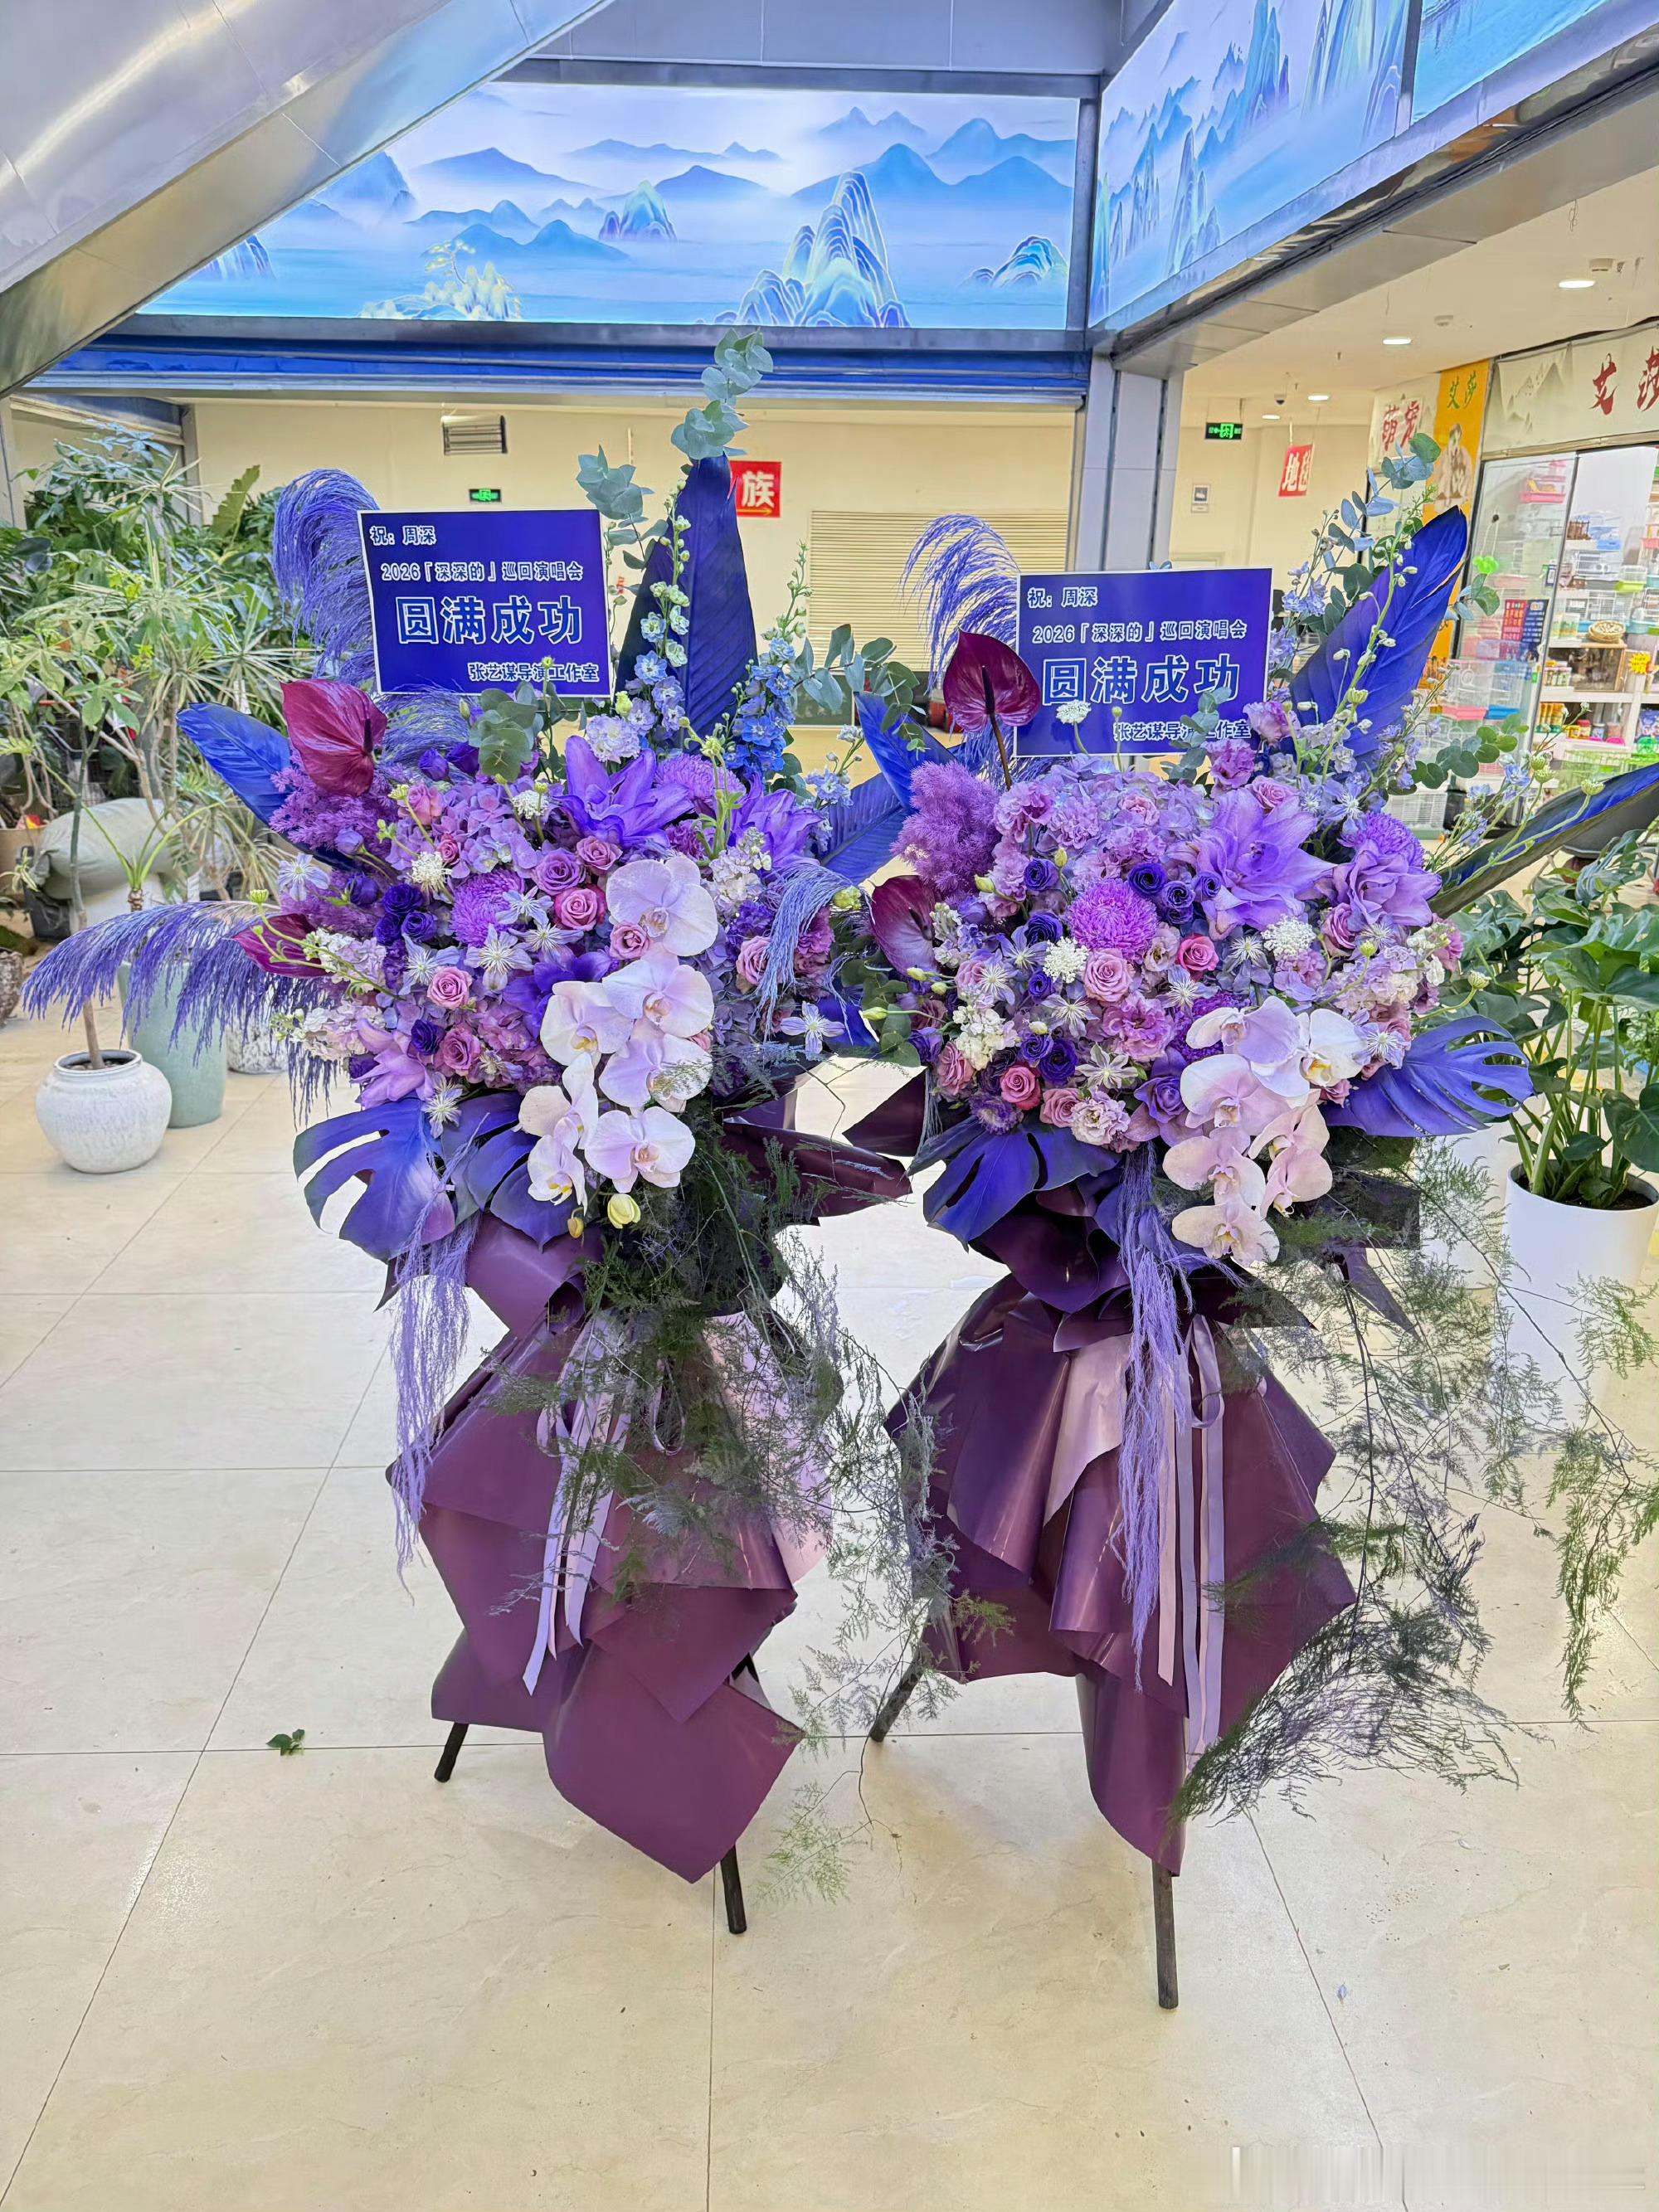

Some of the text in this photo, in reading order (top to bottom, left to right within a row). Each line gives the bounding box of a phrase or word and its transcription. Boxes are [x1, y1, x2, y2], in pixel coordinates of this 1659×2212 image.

[742, 470, 775, 508] 族
[396, 596, 581, 644] 圆满成功
[468, 662, 600, 682] 张艺谋导演工作室
[1042, 653, 1240, 706] 圆满成功
